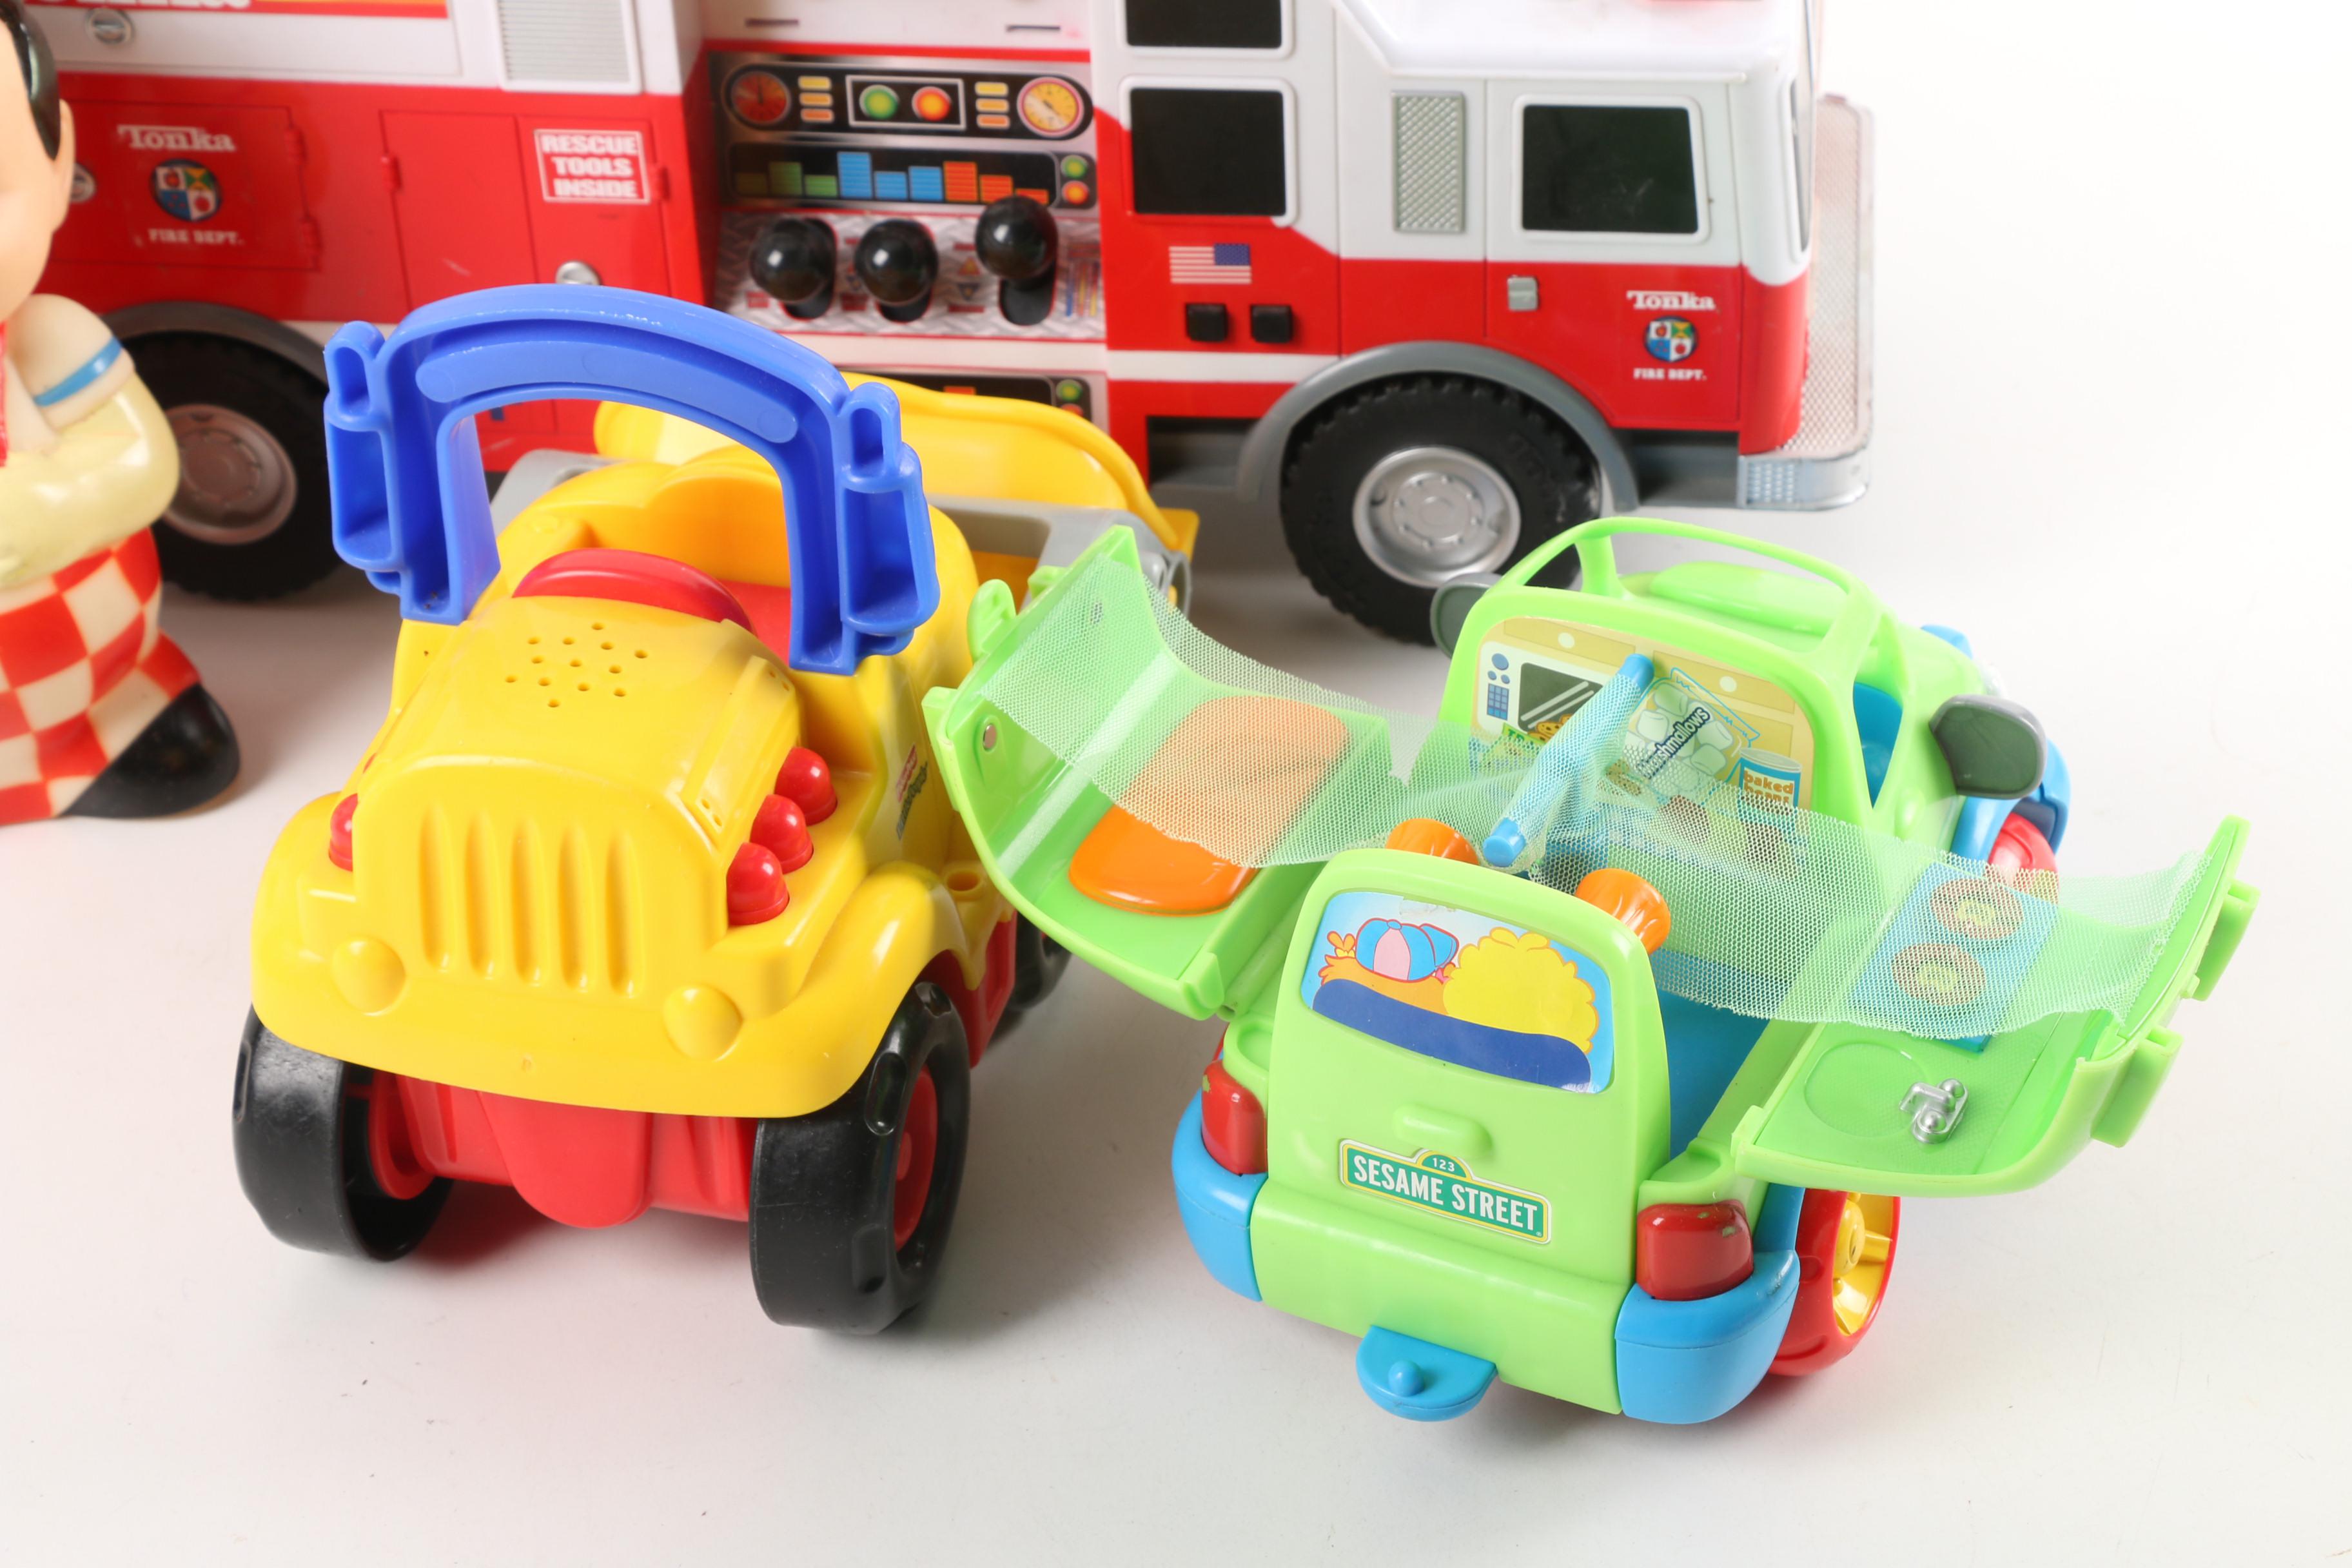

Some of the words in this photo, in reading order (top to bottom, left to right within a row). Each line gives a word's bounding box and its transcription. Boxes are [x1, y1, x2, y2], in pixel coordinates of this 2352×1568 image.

[117, 124, 235, 152] Tonka
[542, 134, 638, 154] RESCUE
[551, 156, 634, 177] TOOLS
[553, 178, 639, 198] INSIDE
[148, 229, 188, 242] FIRE
[1627, 291, 1716, 311] Tonka
[1633, 368, 1665, 379] FIRE
[1743, 770, 1794, 795] baked
[1432, 1157, 1455, 1172] 123
[1353, 1155, 1444, 1206] SESAME
[1451, 1184, 1537, 1231] STREET
